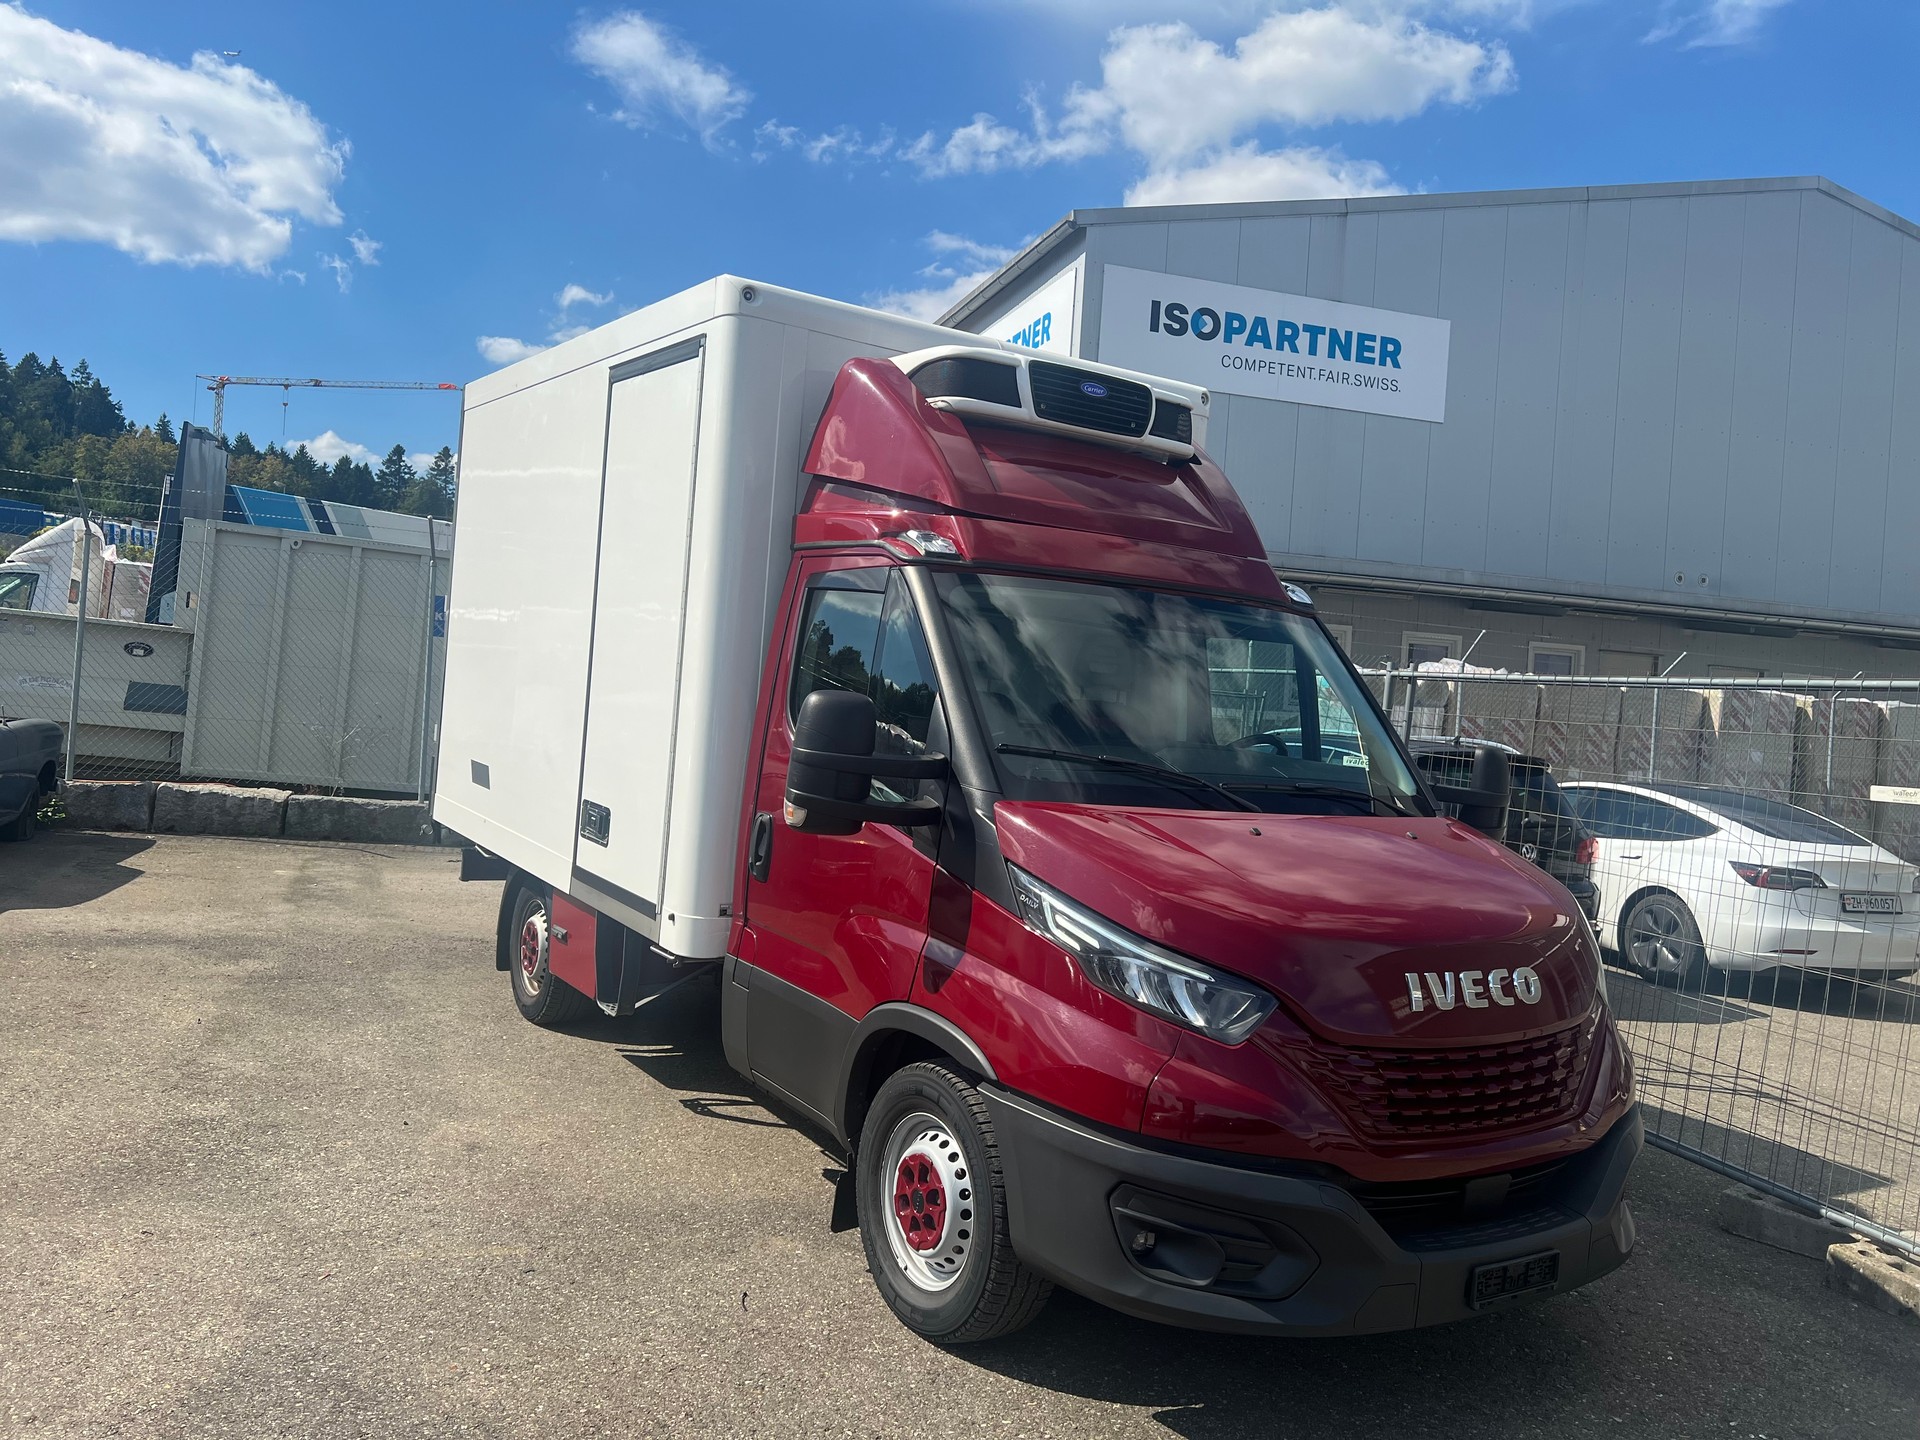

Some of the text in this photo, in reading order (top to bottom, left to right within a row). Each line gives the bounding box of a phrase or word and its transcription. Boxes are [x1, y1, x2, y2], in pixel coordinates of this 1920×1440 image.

[1006, 312, 1052, 349] TNER
[1149, 299, 1402, 370] ISOPARTNER
[1084, 385, 1104, 394] Carrier
[1220, 354, 1402, 393] COMPETENT.FAIR.SWISS.
[1020, 894, 1039, 908] DAILY
[1404, 966, 1542, 1013] IVECO
